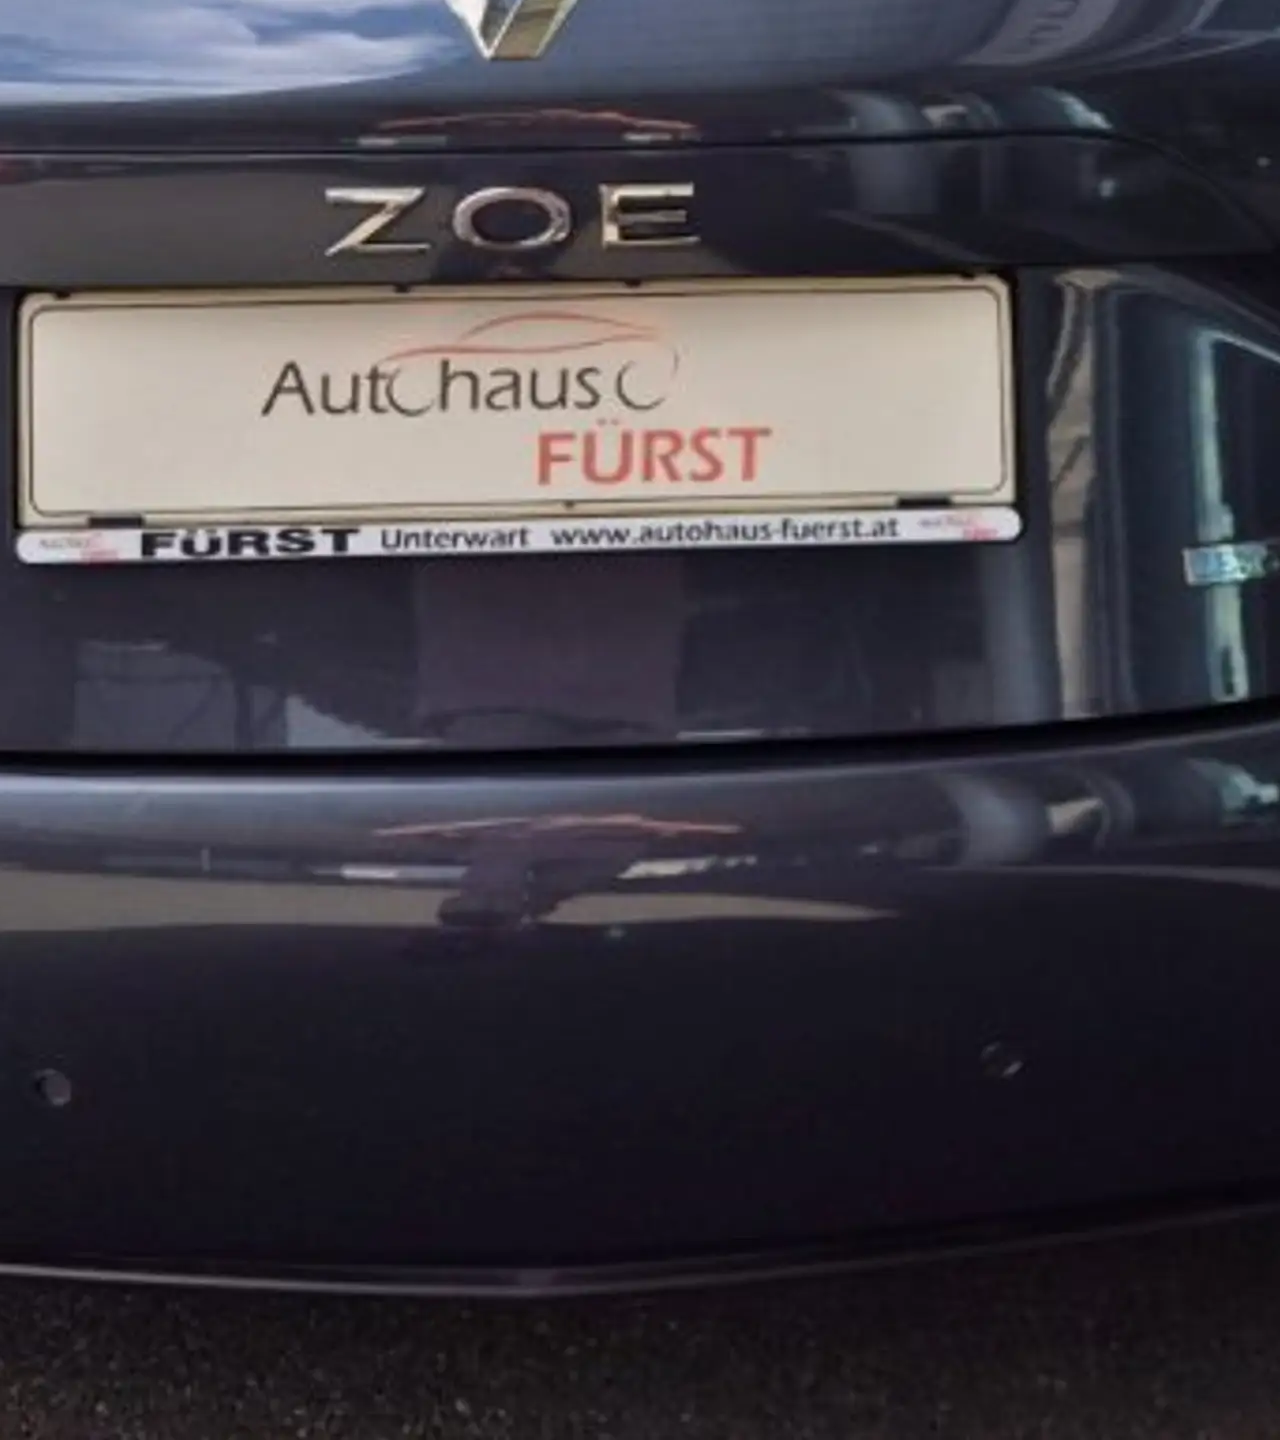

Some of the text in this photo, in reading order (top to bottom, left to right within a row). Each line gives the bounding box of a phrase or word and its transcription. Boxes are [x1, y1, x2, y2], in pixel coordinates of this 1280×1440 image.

[324, 182, 701, 257] ZOE
[537, 418, 773, 486] FÜRST
[141, 527, 361, 559] FÜRST
[380, 525, 531, 551] Unterwart
[550, 516, 900, 547] www.autohaus-fuerst.at
